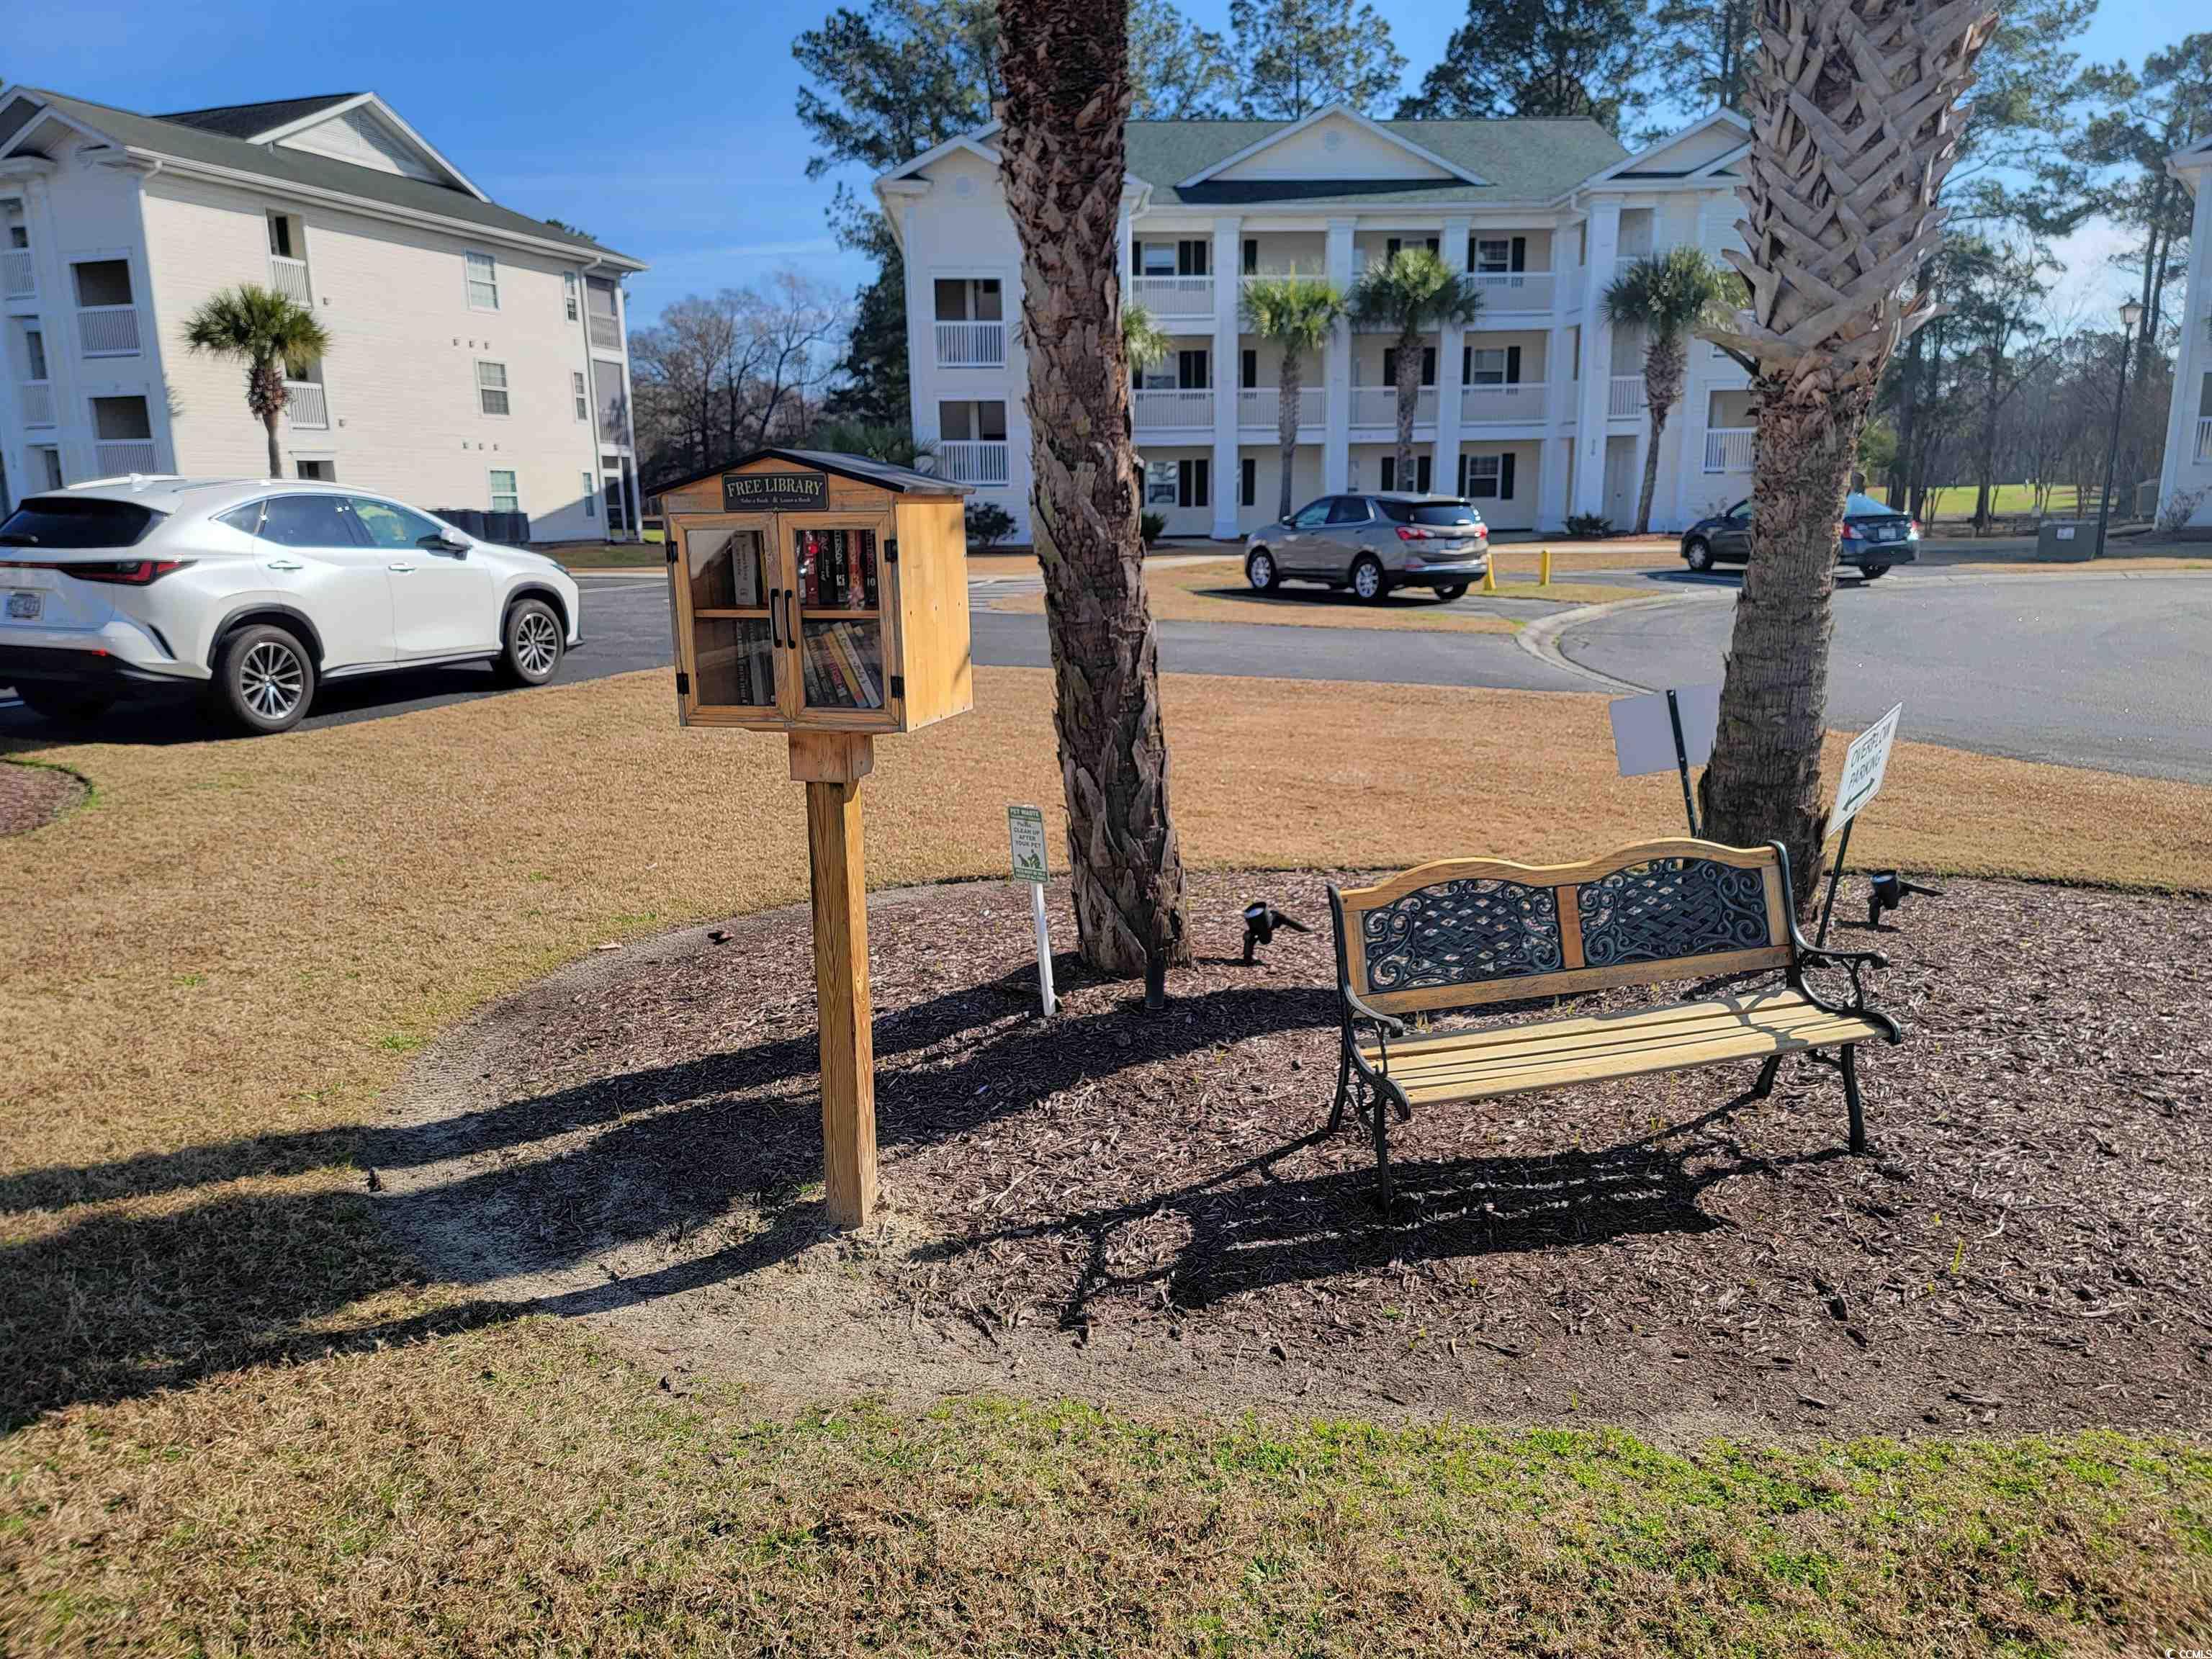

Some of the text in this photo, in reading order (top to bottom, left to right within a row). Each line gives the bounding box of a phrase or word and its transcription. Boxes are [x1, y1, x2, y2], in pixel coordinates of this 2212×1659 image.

[727, 478, 823, 498] FREE LIBRARY
[1848, 748, 1882, 791] PARKING
